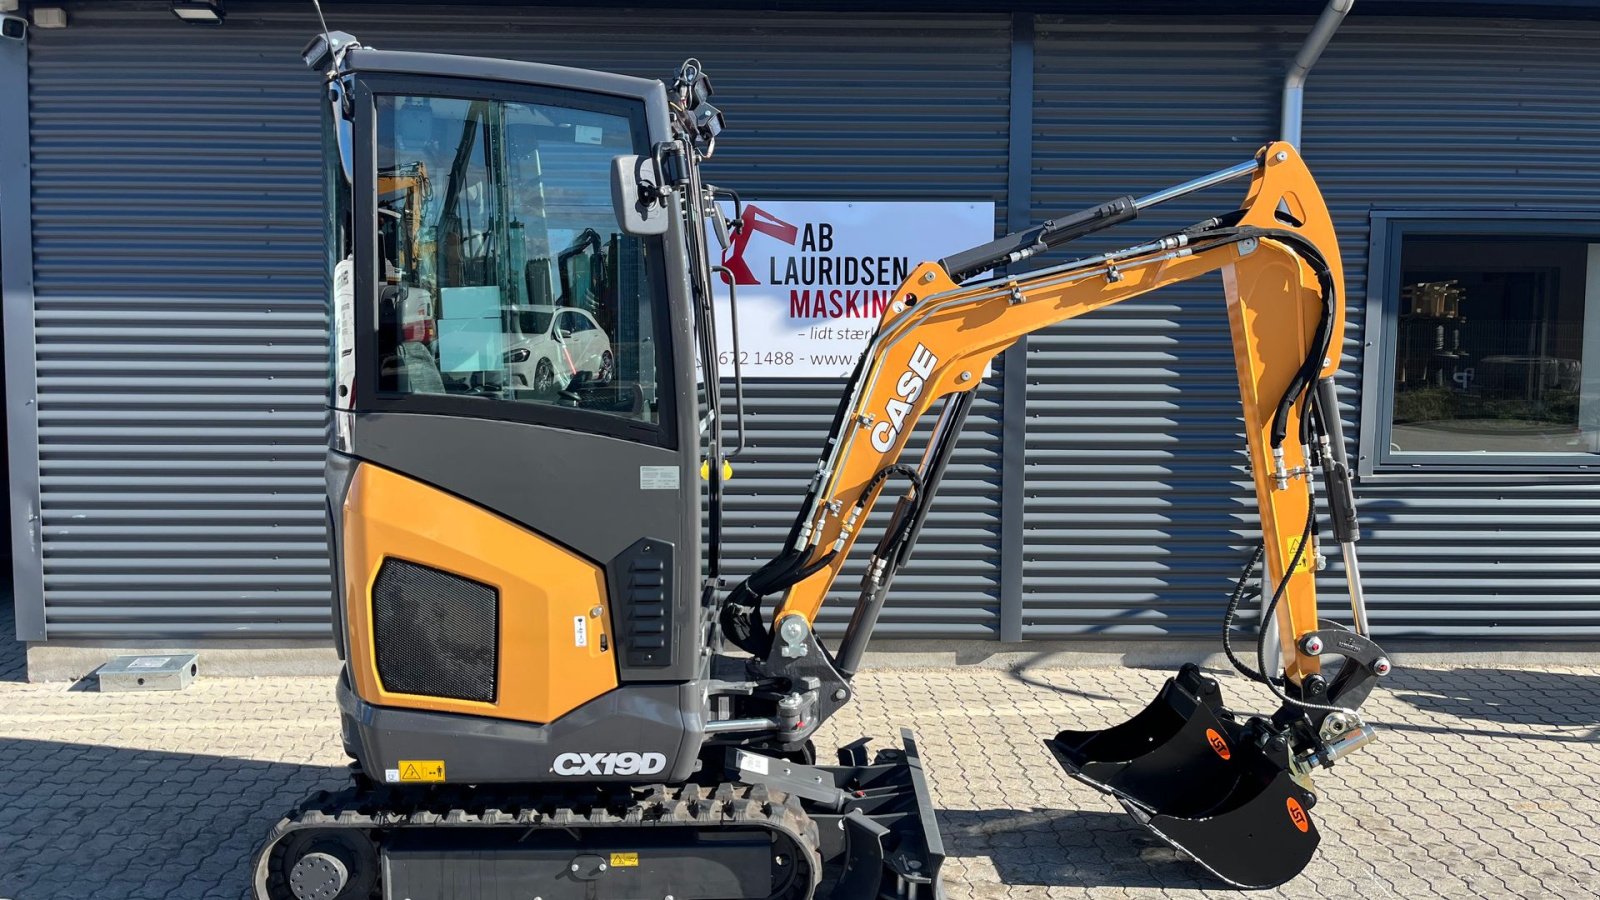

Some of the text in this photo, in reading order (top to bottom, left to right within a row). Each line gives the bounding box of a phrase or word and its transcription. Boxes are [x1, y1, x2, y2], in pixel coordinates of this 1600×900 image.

[801, 223, 834, 252] AB
[769, 256, 908, 286] LAURIDSEN
[790, 289, 897, 318] MASKIN
[810, 327, 833, 340] lidt
[718, 351, 749, 366] 672
[753, 351, 794, 366] 1488
[870, 341, 939, 454] CASE
[1210, 737, 1227, 753] JST
[552, 751, 667, 776] CX19D
[1290, 806, 1306, 824] JST
